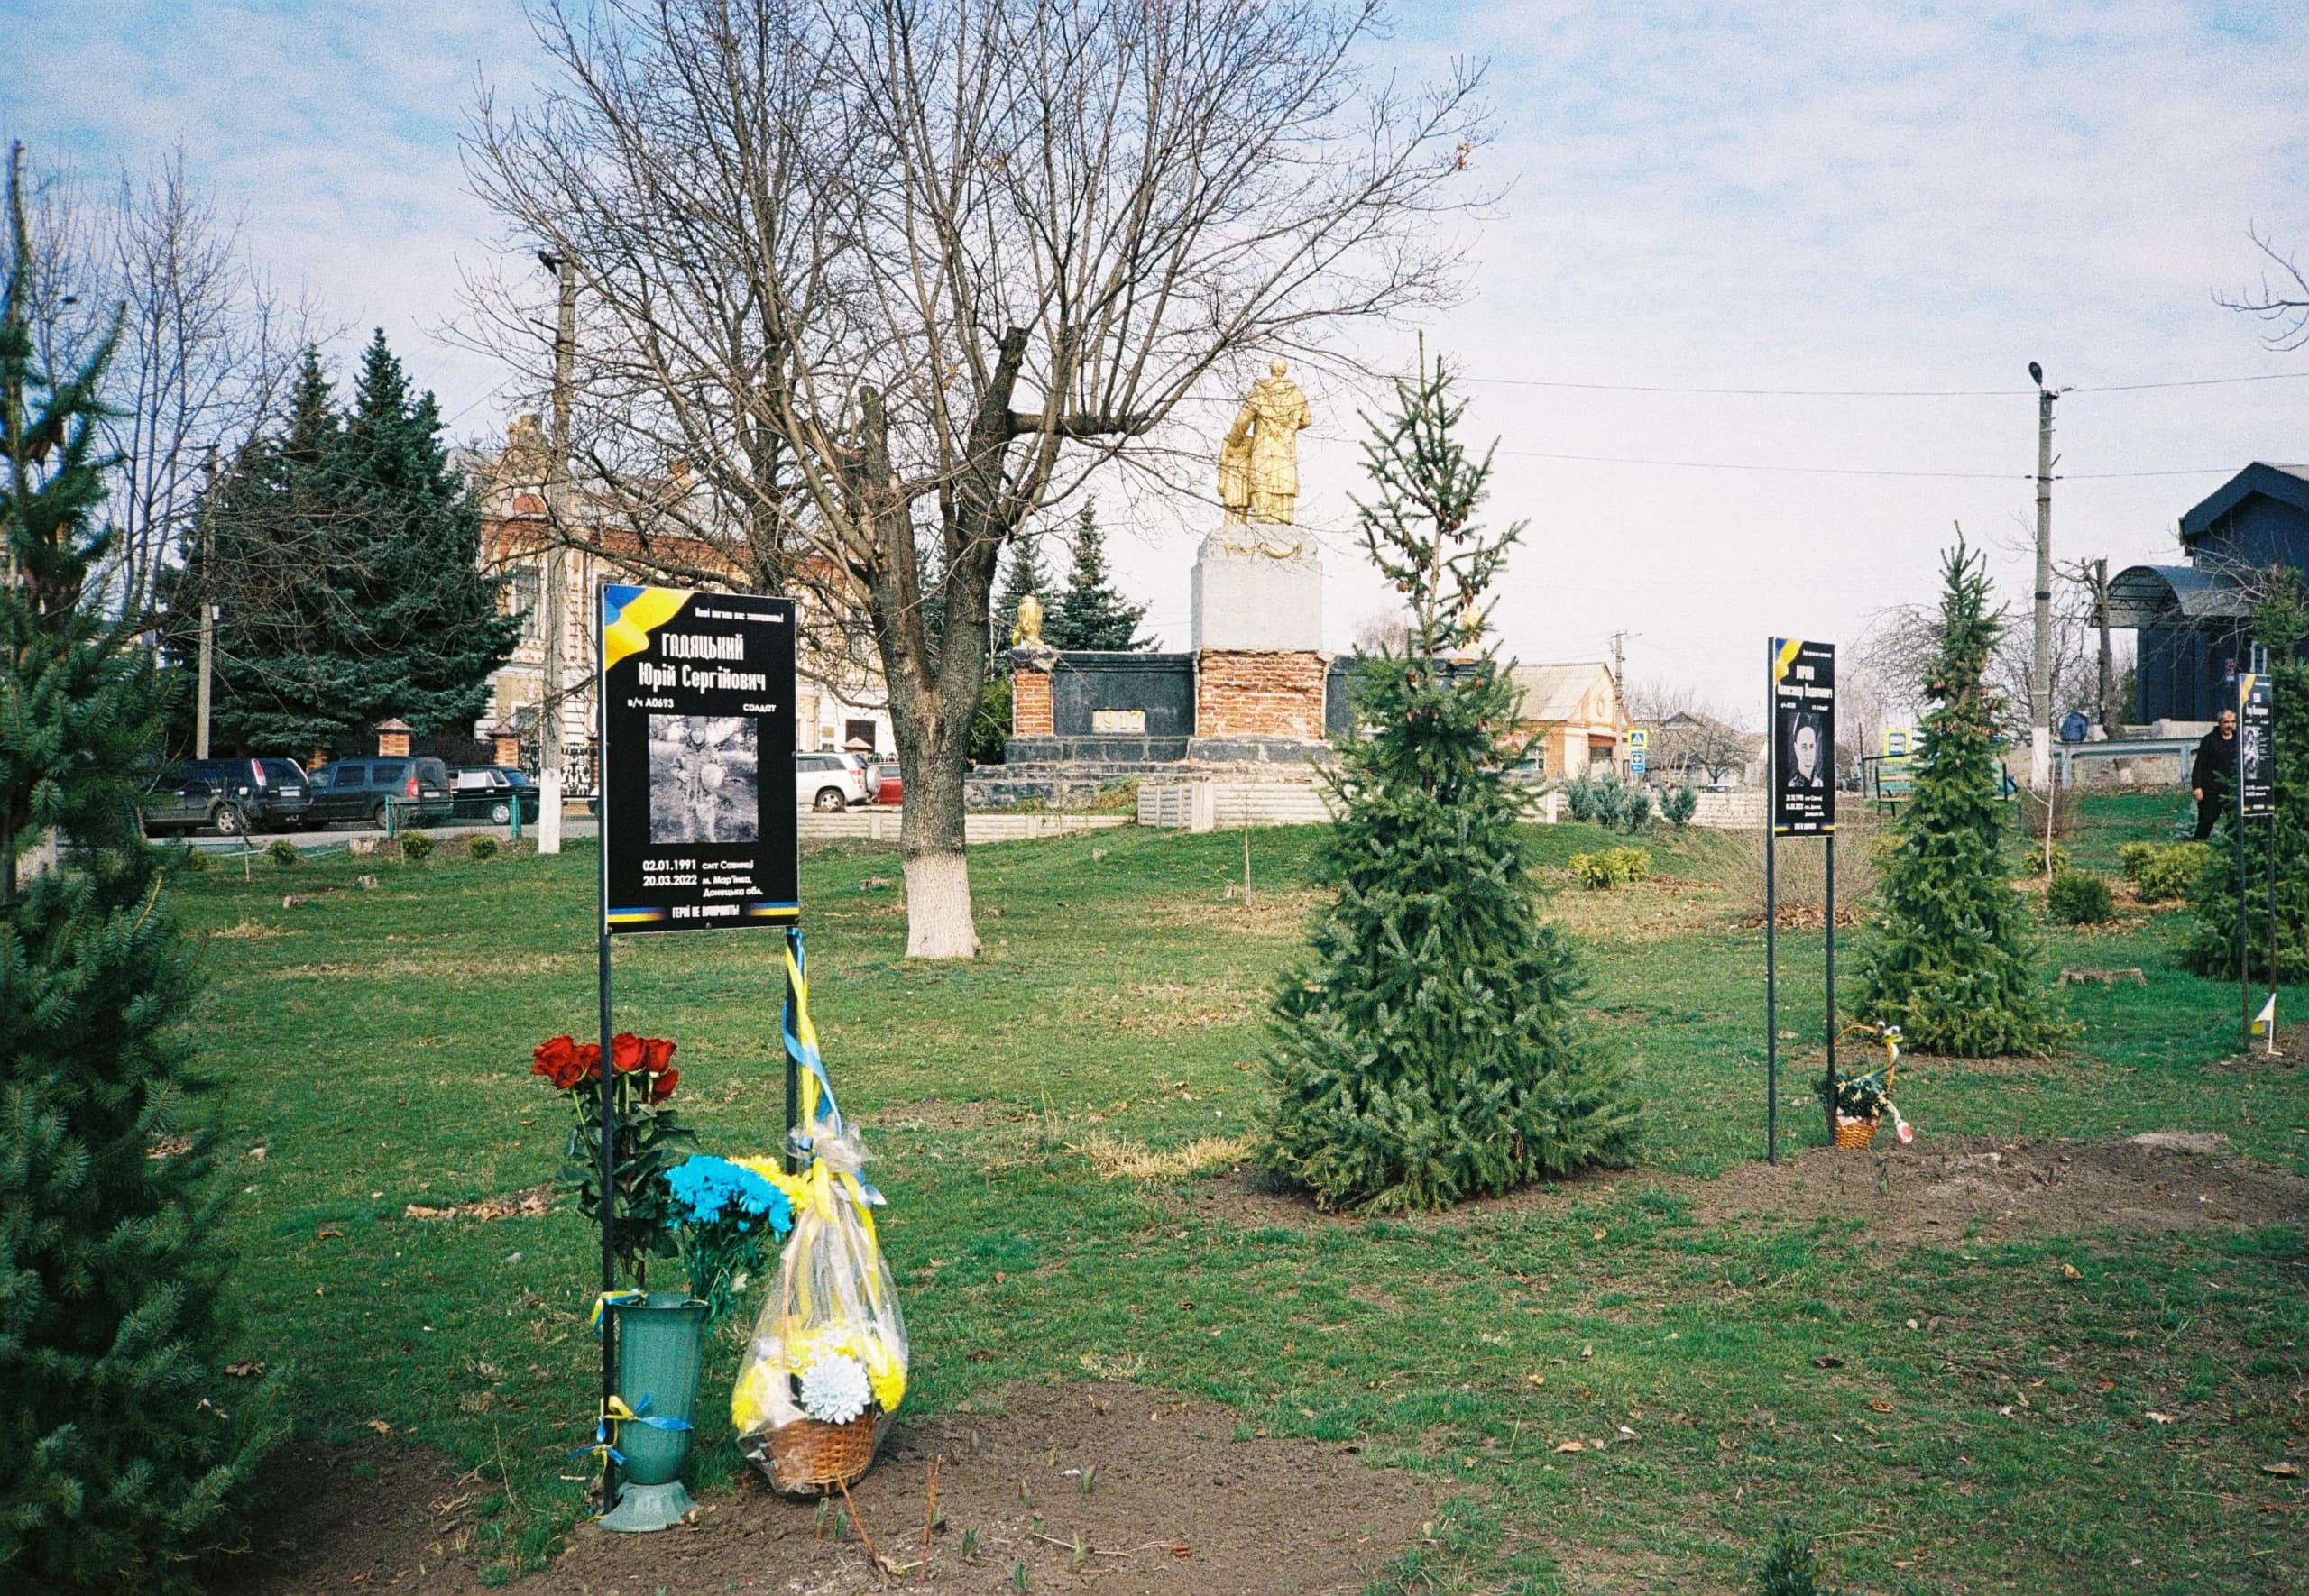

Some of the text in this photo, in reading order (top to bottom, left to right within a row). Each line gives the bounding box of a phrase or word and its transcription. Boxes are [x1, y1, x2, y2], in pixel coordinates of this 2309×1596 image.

[639, 662, 766, 694] Юрій Сергійович
[643, 859, 695, 871] 02.01.1991
[643, 875, 697, 886] 20.03.2022
